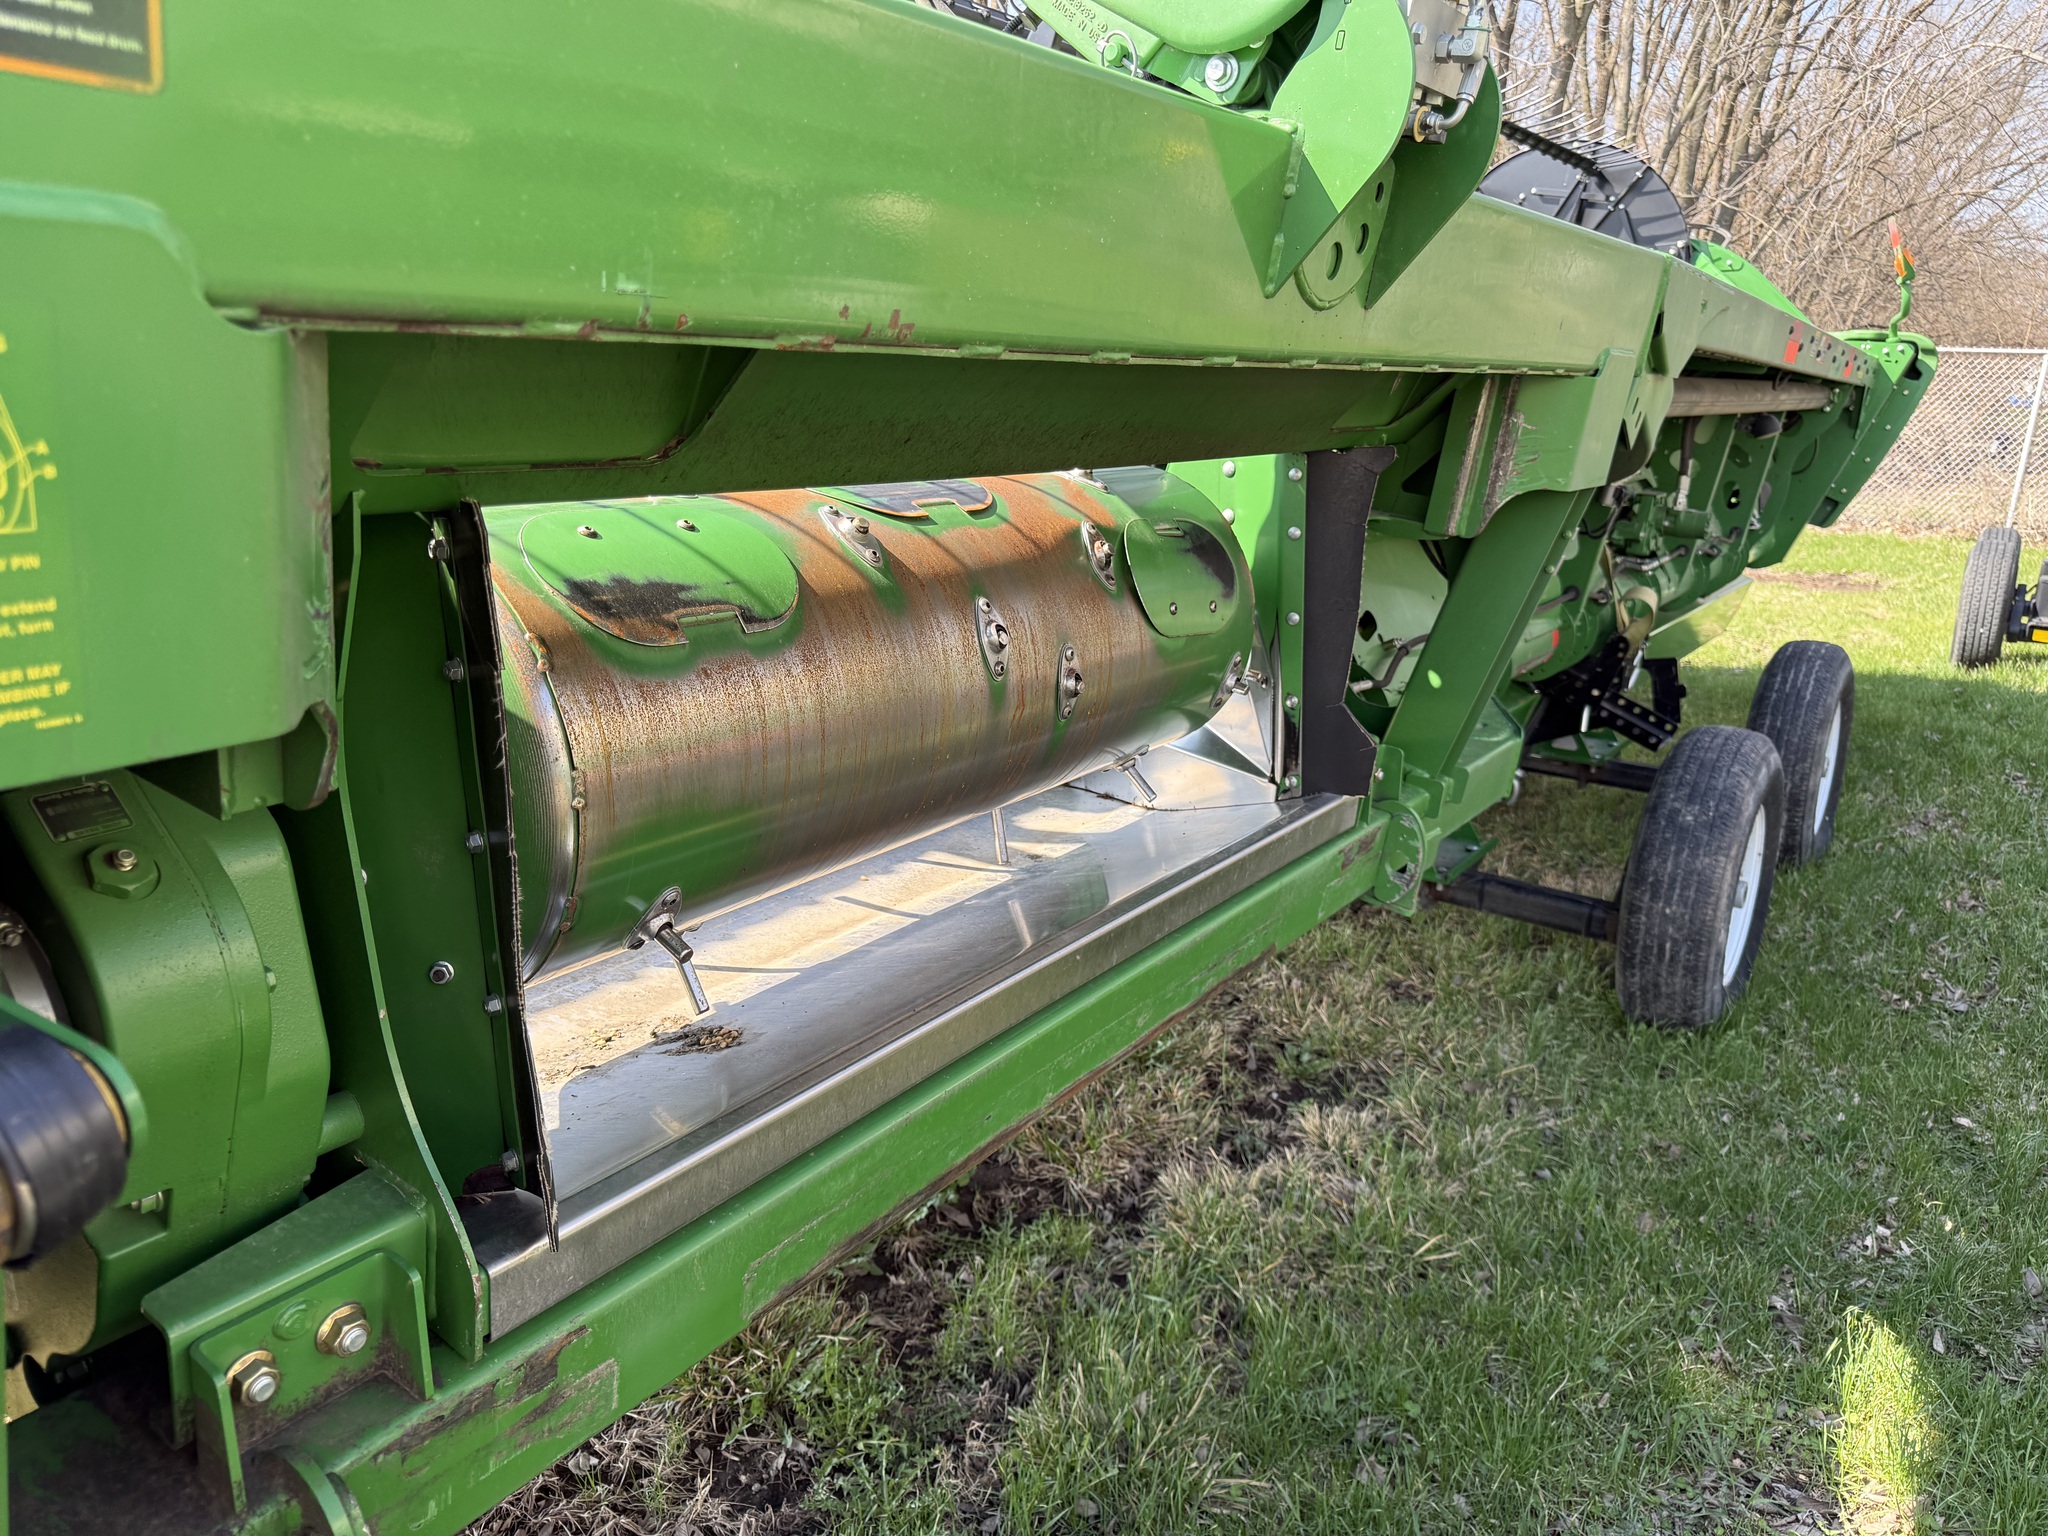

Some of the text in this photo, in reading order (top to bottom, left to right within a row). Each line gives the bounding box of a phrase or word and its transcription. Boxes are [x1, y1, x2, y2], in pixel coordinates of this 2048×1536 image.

[1051, 0, 1077, 22] MADE
[1077, 19, 1088, 31] IN
[10, 553, 42, 572] PIN
[0, 597, 57, 619] extend
[18, 619, 54, 636] turn
[27, 663, 62, 681] MAY
[54, 680, 71, 696] IF
